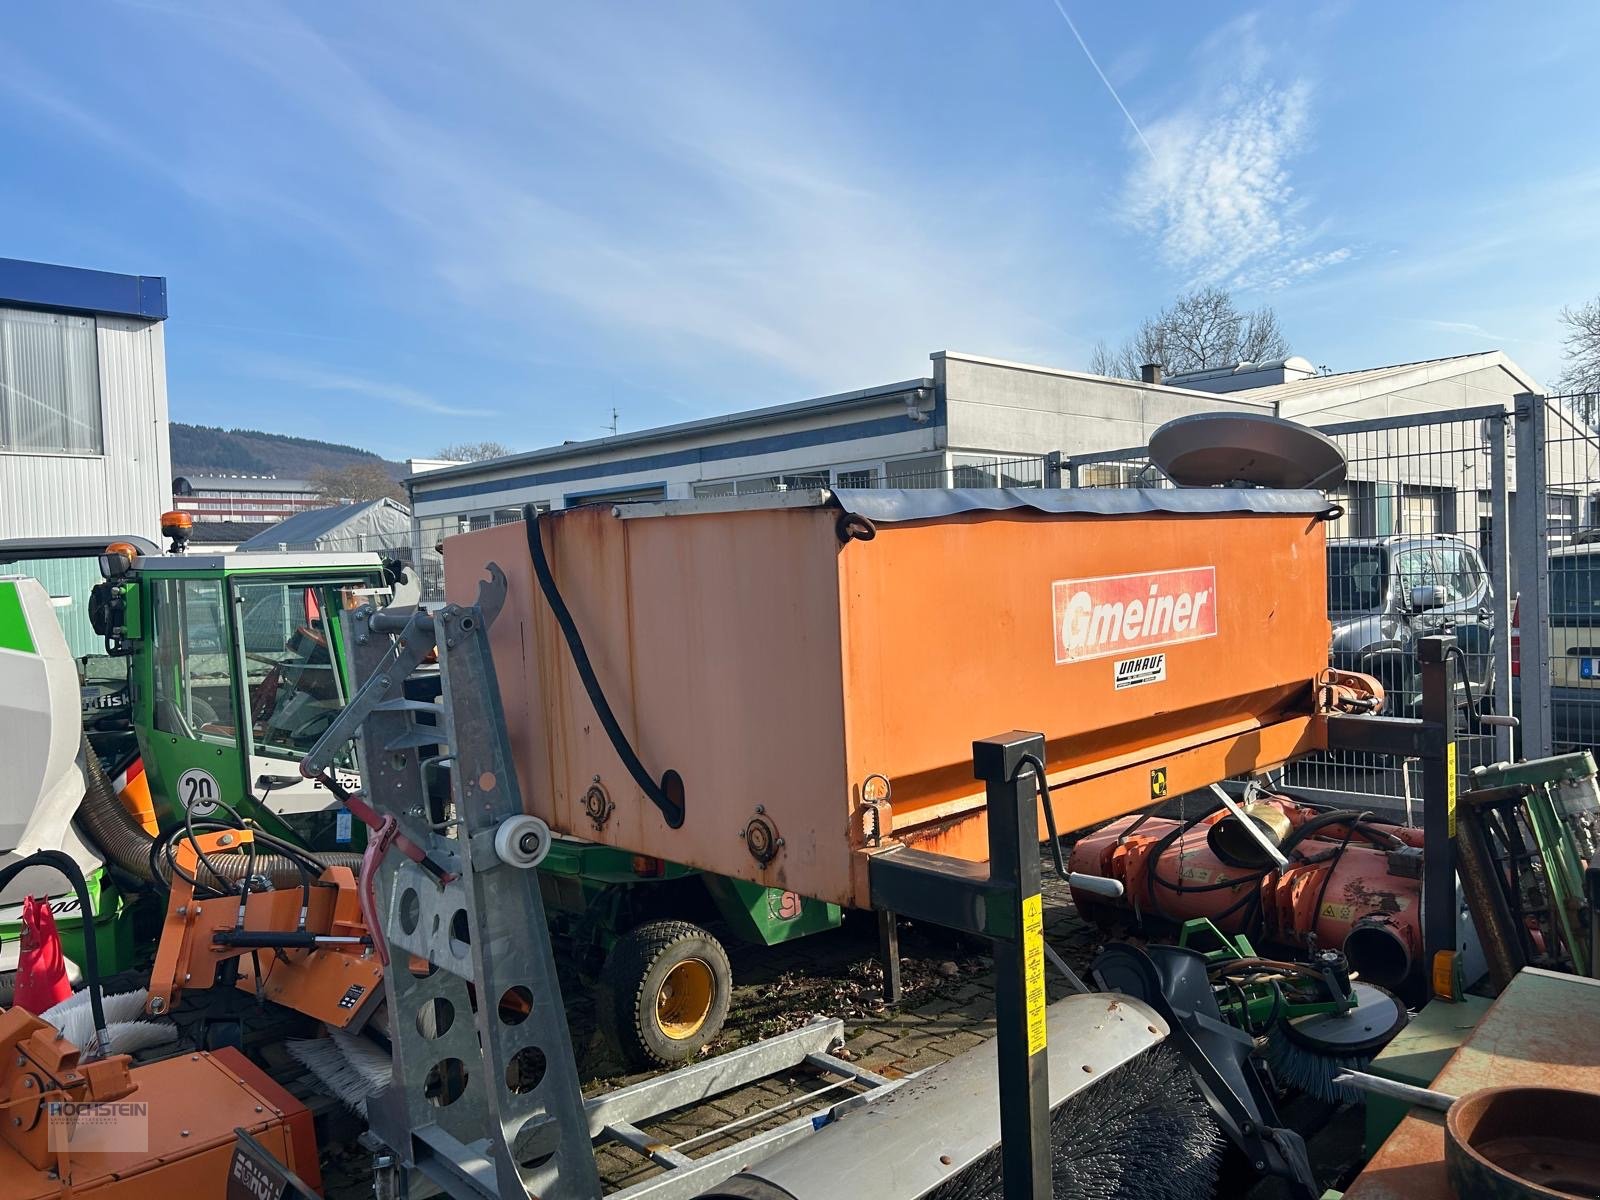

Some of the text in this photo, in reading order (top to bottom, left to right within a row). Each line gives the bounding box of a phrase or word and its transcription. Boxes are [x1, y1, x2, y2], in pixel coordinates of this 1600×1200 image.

[1061, 583, 1209, 649] Gmeiner
[1119, 654, 1164, 675] UNKAUF
[185, 777, 212, 808] 20
